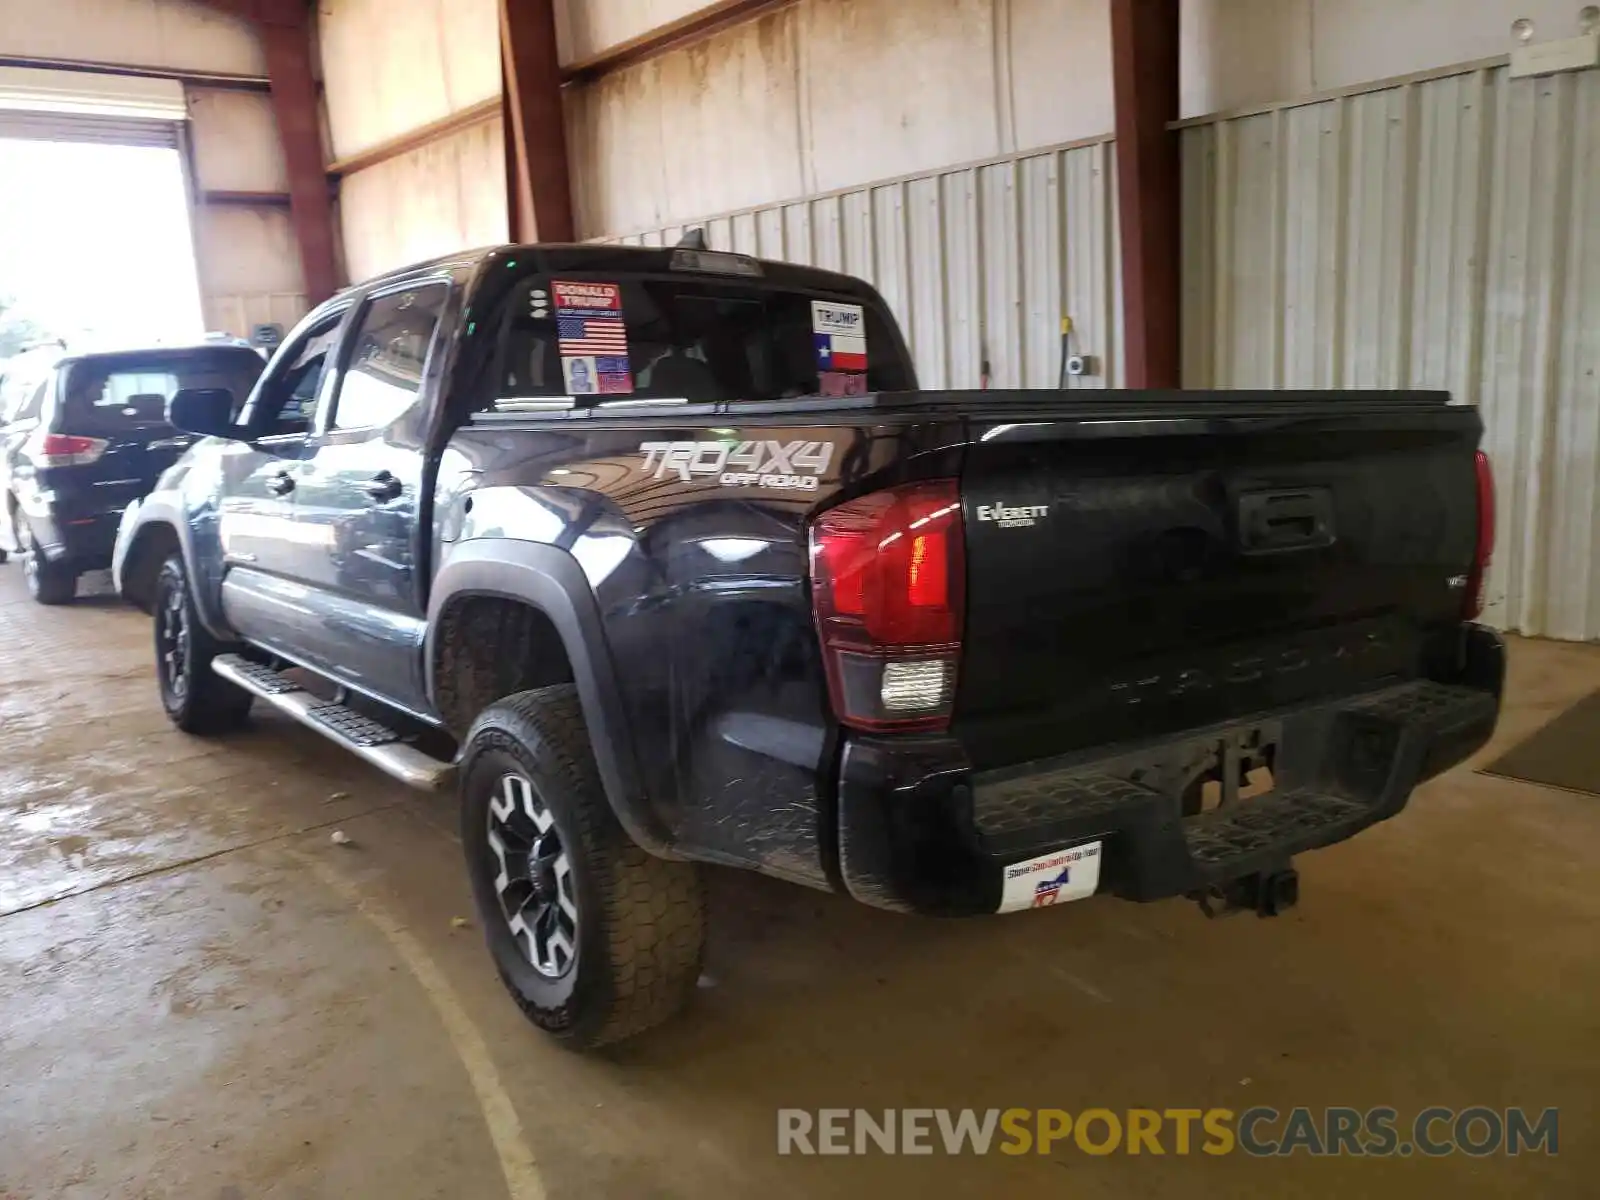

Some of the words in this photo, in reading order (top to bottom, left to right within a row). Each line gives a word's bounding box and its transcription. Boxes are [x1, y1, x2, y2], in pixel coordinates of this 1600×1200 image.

[554, 284, 616, 298] DONALD
[560, 295, 613, 308] TRUMP
[817, 308, 860, 325] TRUMP
[639, 440, 729, 483] TRD
[758, 474, 820, 492] ROAD
